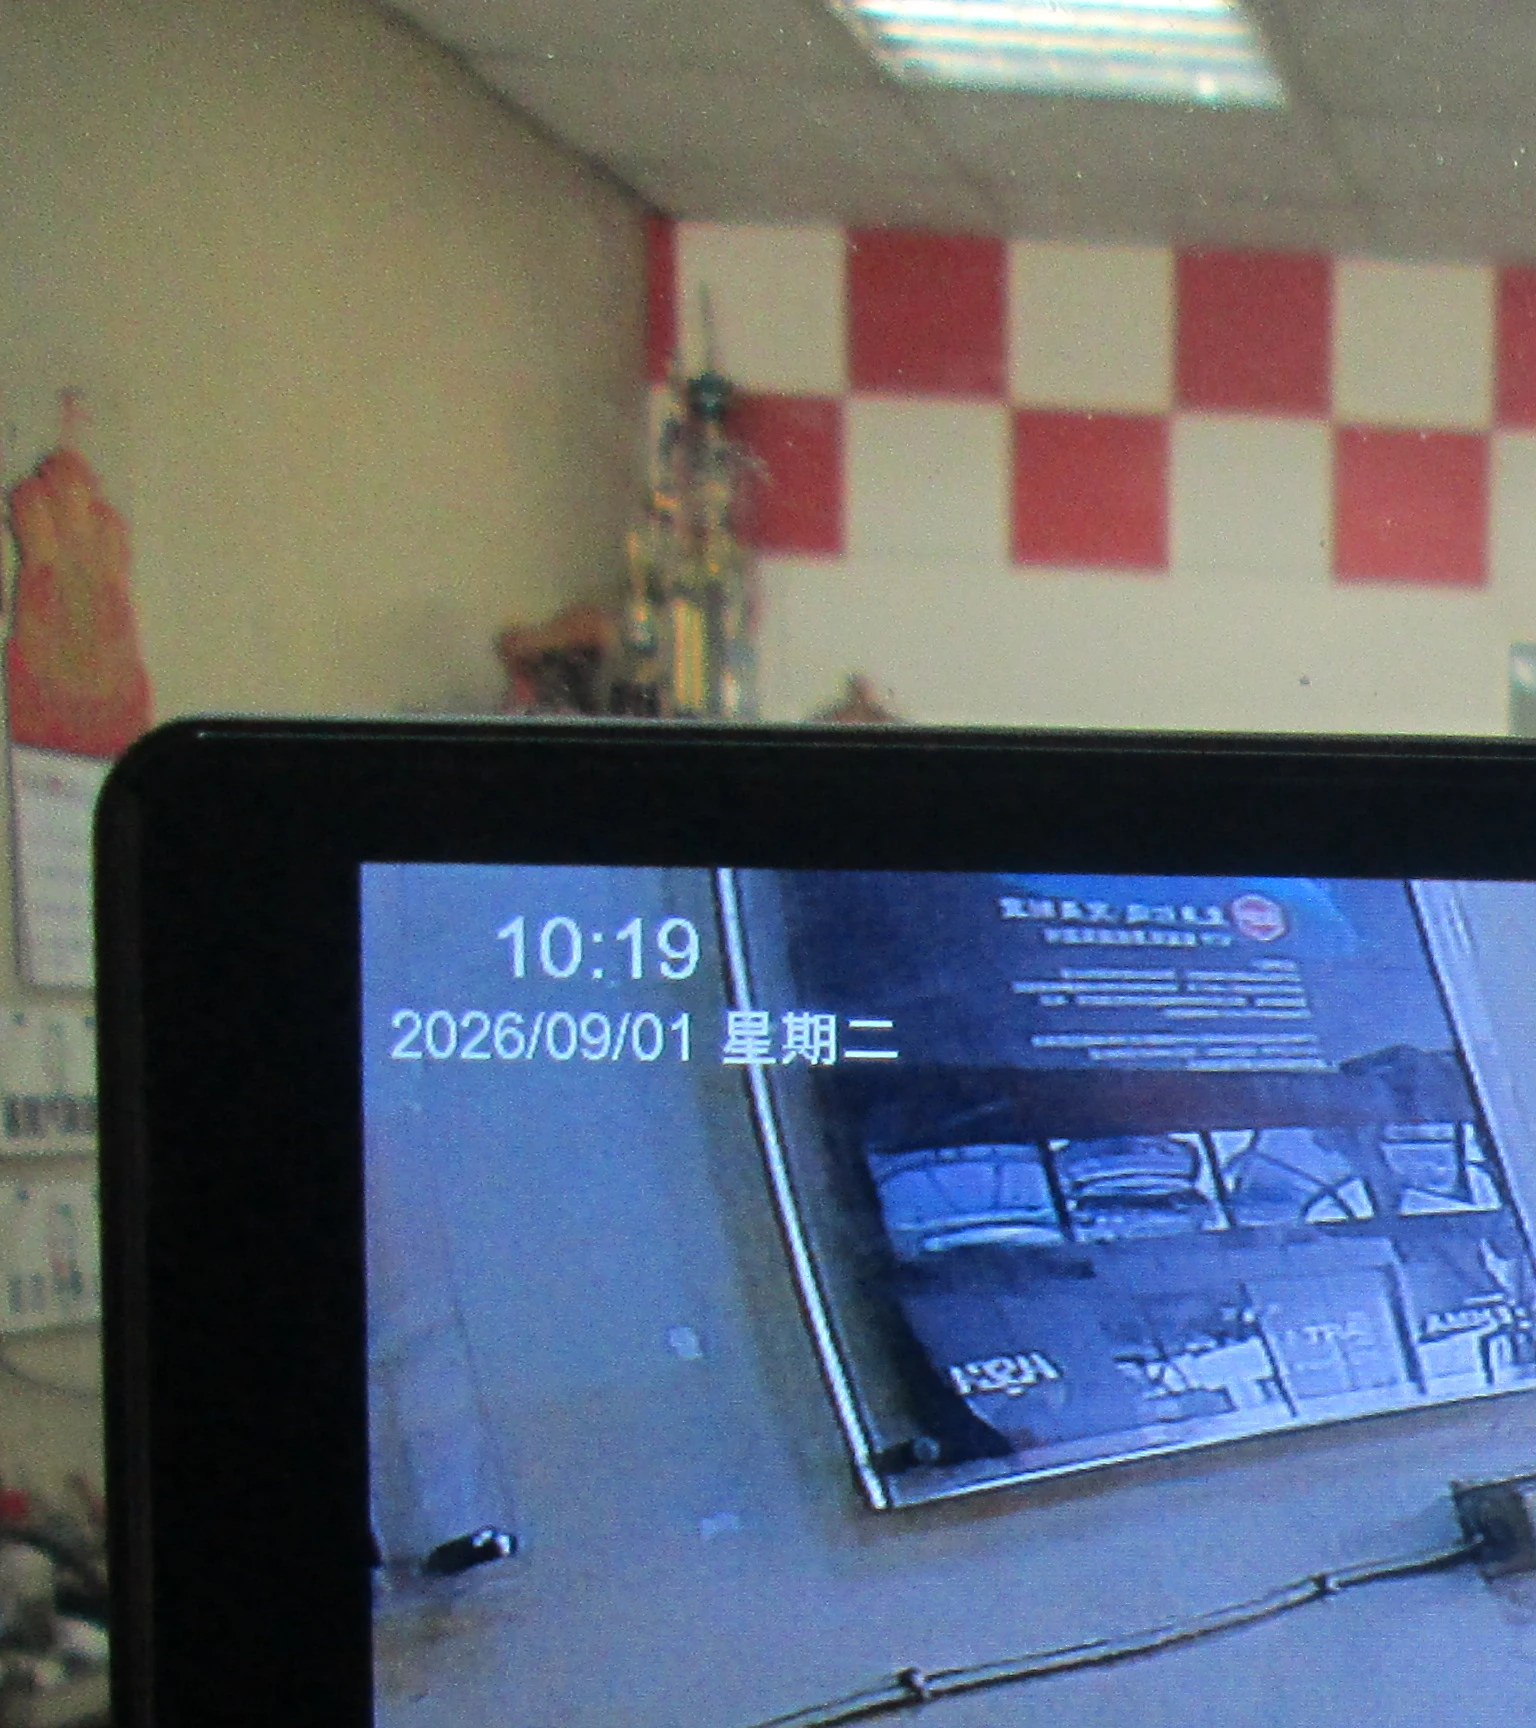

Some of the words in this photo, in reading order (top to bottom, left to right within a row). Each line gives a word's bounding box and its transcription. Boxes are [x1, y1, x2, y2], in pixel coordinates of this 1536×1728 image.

[497, 916, 700, 980] 10:19
[390, 1010, 693, 1062] 2026/09/01
[721, 1010, 899, 1066] 星期二
